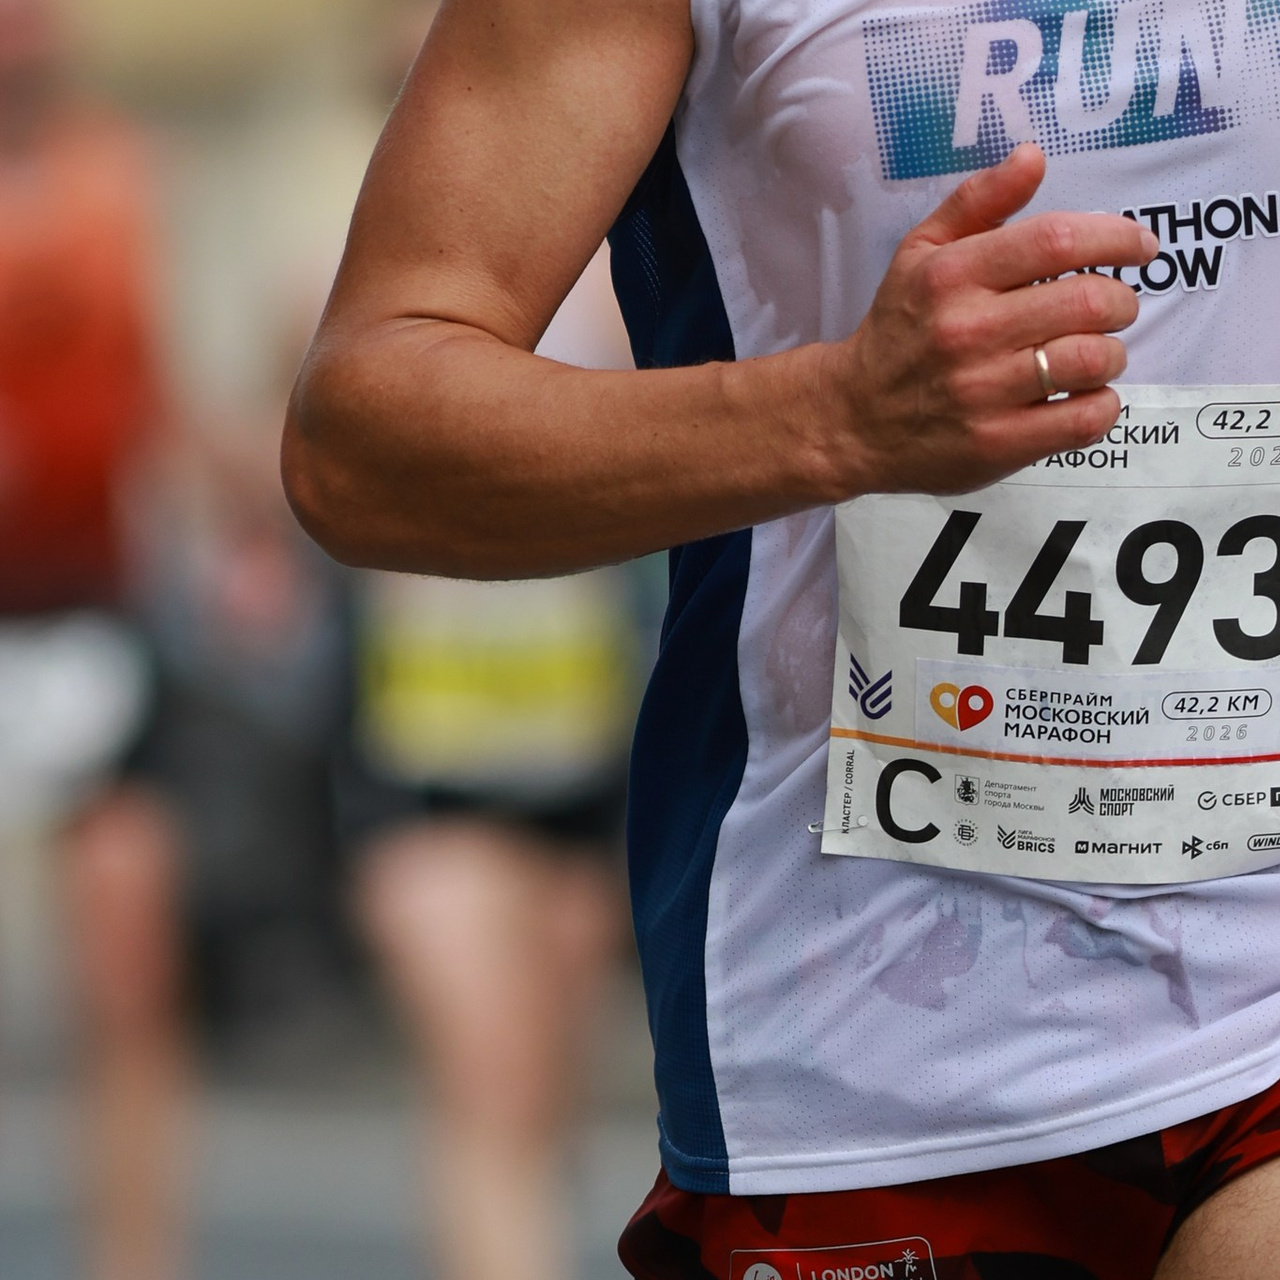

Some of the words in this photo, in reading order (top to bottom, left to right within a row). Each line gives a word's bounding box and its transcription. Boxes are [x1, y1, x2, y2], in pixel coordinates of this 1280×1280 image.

[1121, 194, 1279, 244] THON
[1212, 410, 1271, 433] 42,2
[1031, 449, 1128, 469] АФОН
[1005, 688, 1113, 707] СБЕРПРАЙМ
[1174, 696, 1219, 715] 42,2
[1004, 704, 1150, 726] МОСКОВСКИЙ
[1003, 722, 1111, 744] МАРАФОН
[1186, 724, 1248, 741] 2026
[845, 749, 855, 785] CORRAL
[984, 780, 1037, 792] Департамент
[984, 790, 1011, 799] спорта
[1100, 784, 1175, 802] МОСКОВСКИЙ
[984, 800, 1011, 808] города
[1013, 802, 1044, 811] Москвы
[1222, 792, 1267, 807] СБЕР
[842, 792, 852, 835] КЛАСТЕР
[1099, 803, 1135, 817] СПОРТ
[1017, 840, 1055, 854] BRICS
[1206, 840, 1229, 852] сбп
